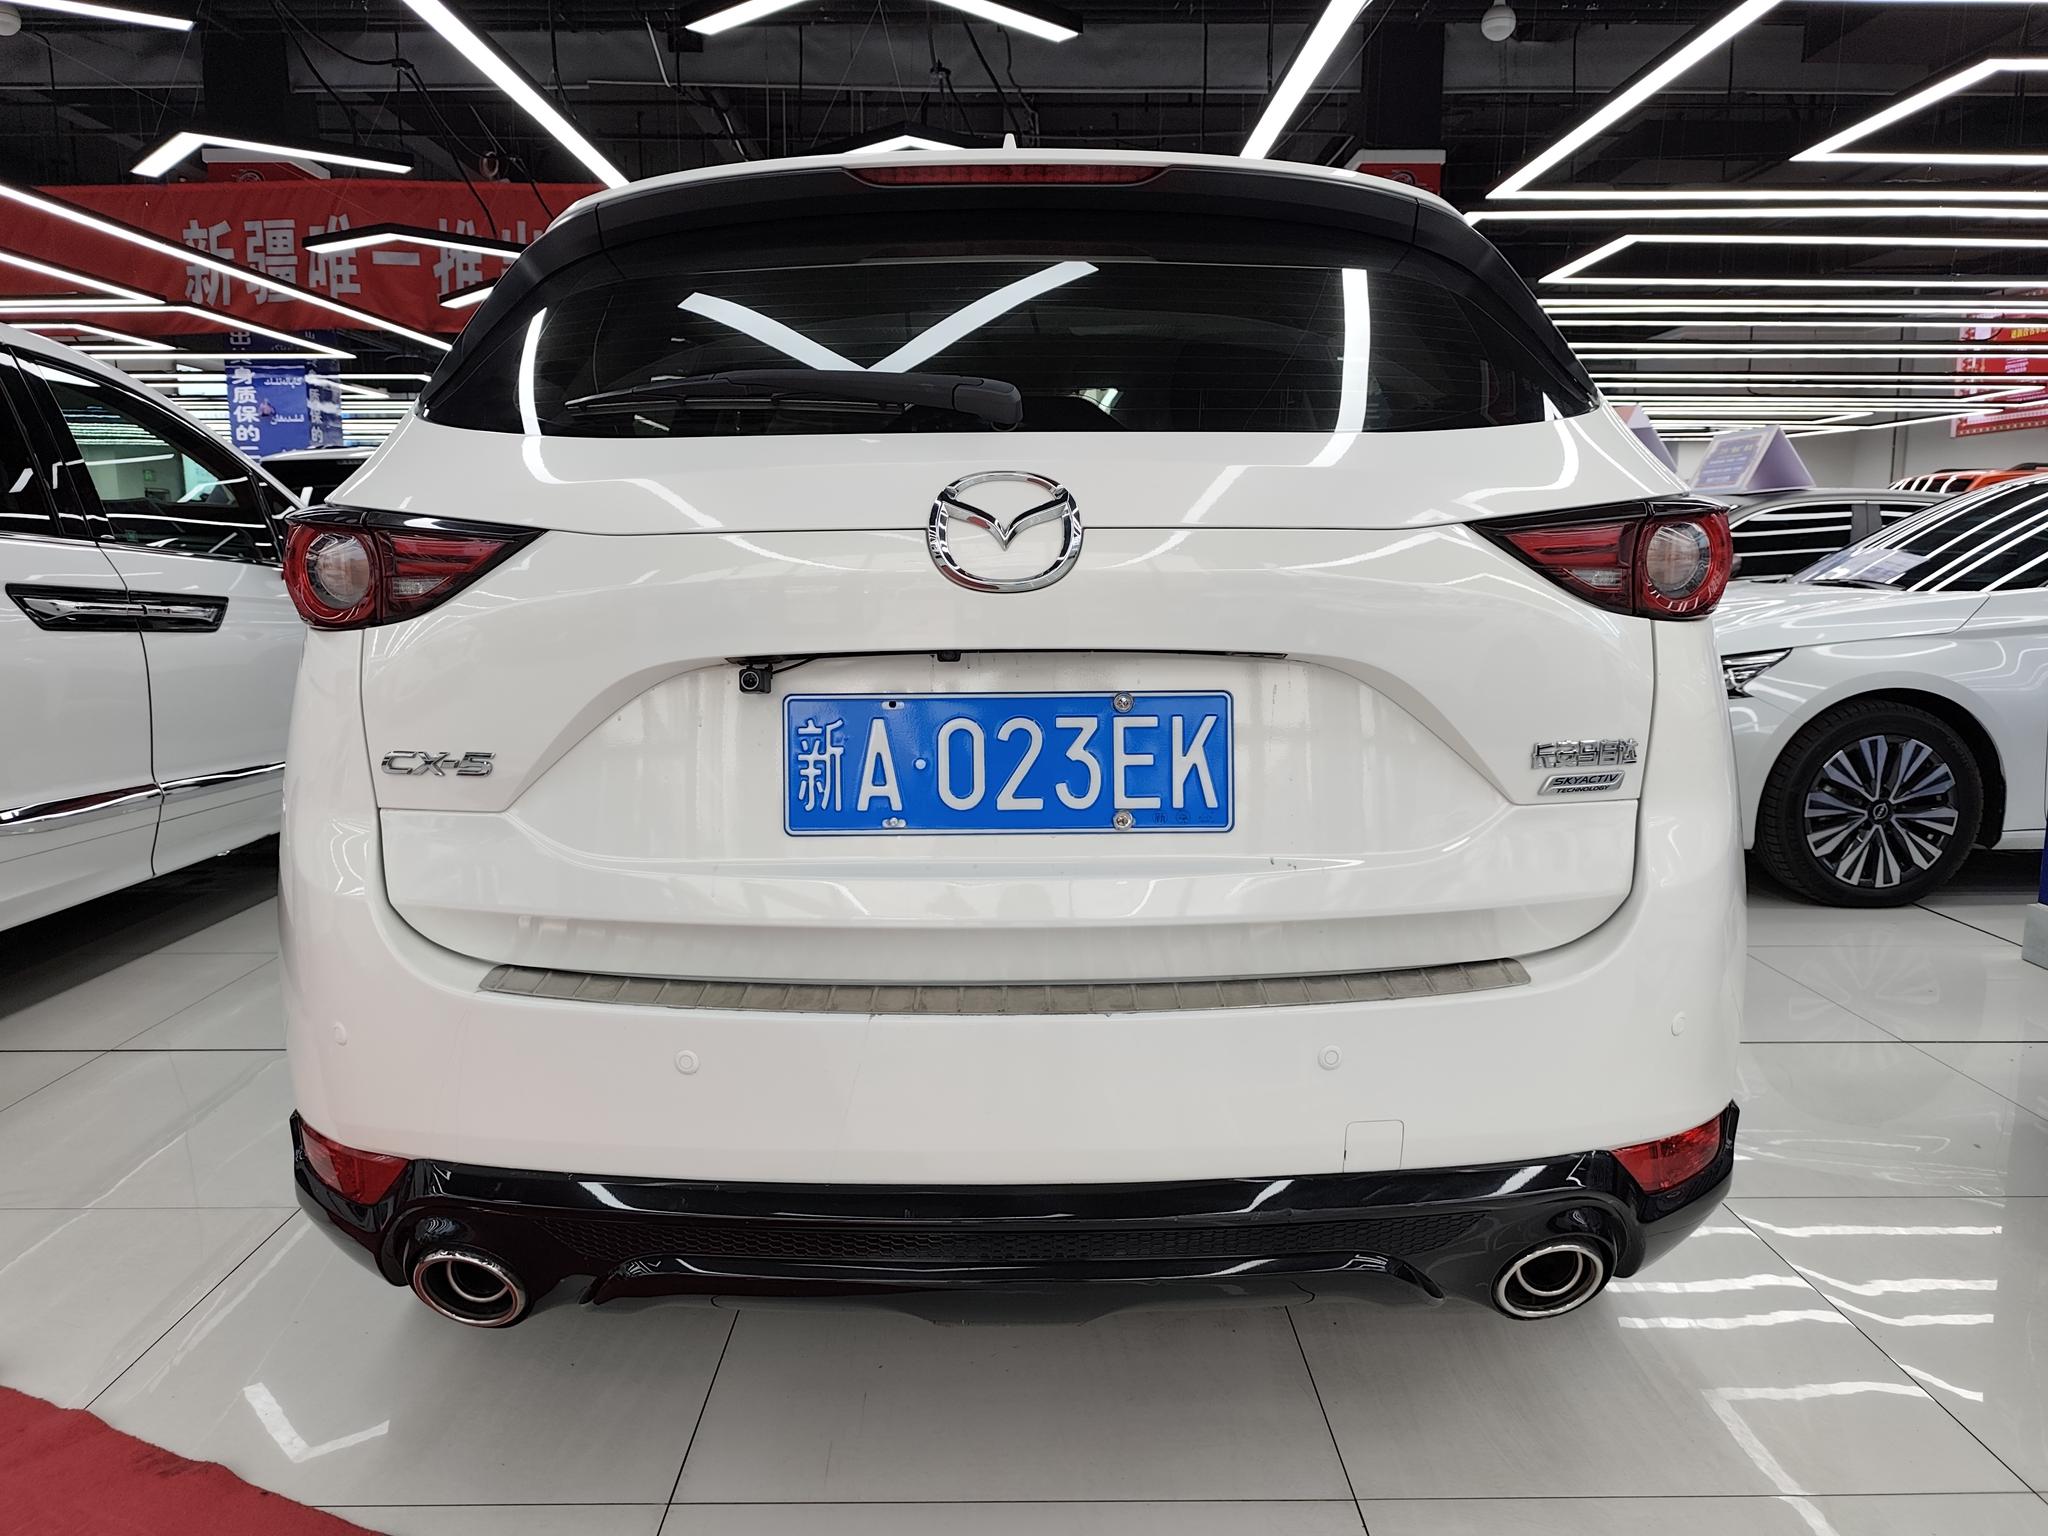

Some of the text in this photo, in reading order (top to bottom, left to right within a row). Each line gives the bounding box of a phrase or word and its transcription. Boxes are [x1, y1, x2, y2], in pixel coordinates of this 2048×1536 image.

[381, 750, 497, 777] CX-5
[1552, 773, 1619, 786] SKYACTIV
[1556, 785, 1611, 794] TECHNOLOGY
